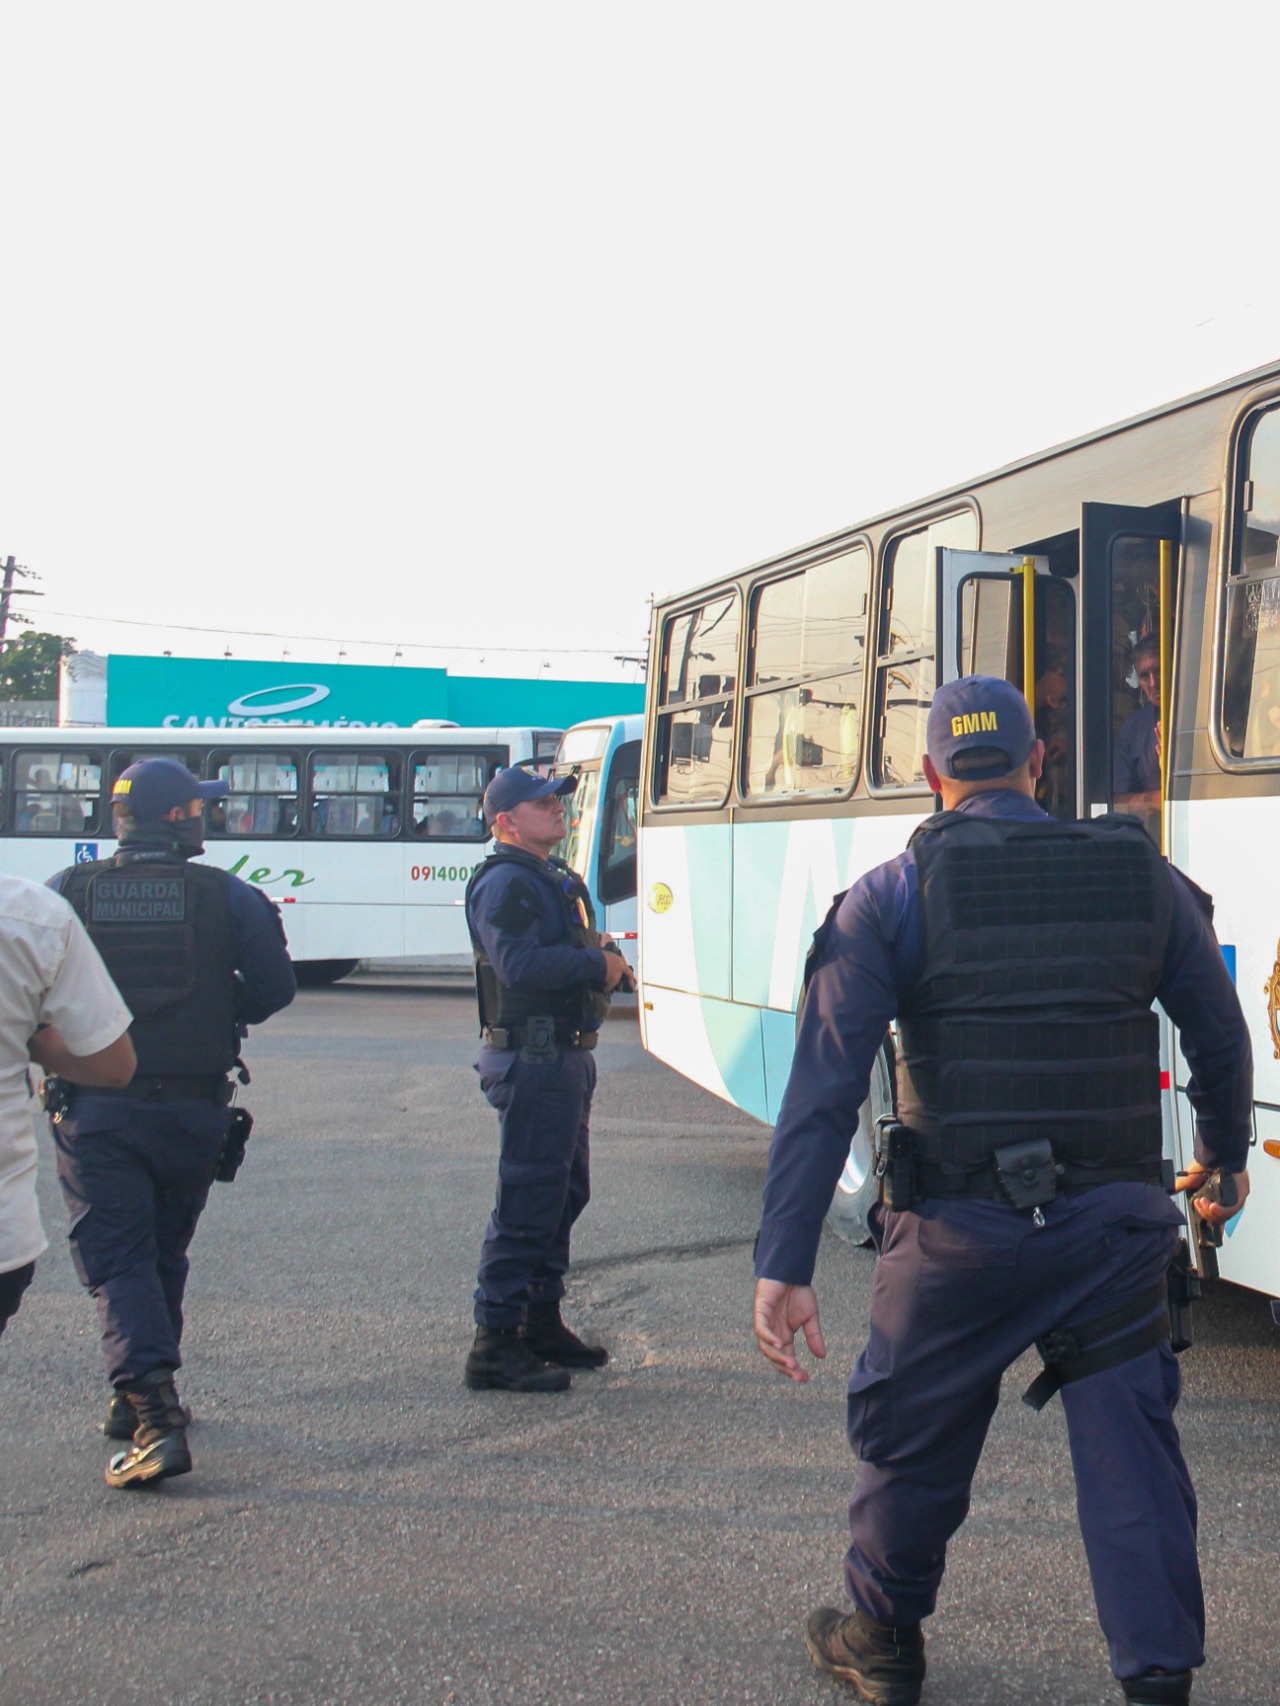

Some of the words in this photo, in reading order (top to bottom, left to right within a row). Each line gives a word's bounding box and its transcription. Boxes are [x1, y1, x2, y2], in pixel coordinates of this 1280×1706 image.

[950, 711, 999, 737] GMM
[97, 882, 180, 899] GUARDA
[96, 901, 181, 917] MUNICIPAL
